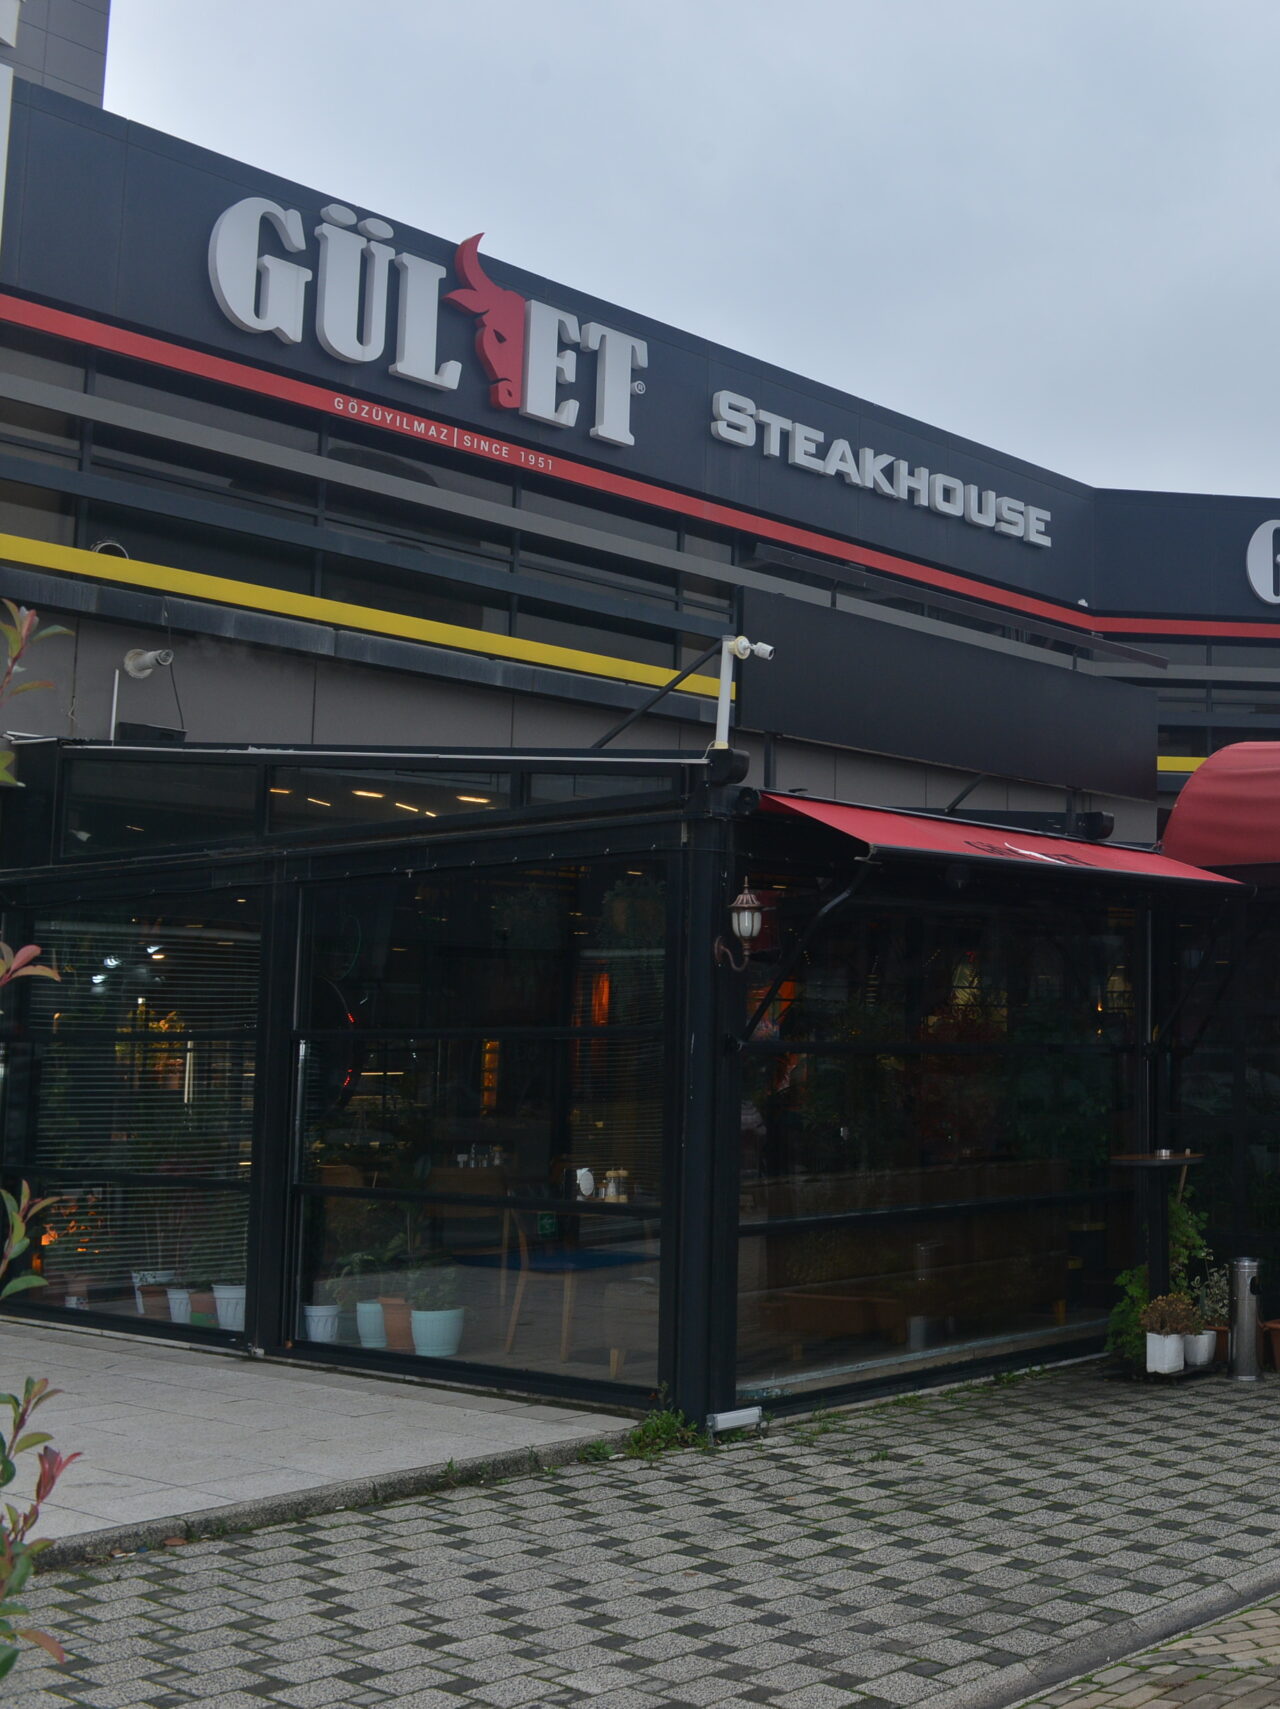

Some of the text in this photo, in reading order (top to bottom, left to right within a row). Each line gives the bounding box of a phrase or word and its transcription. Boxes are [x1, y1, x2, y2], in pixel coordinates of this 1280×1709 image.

[208, 196, 649, 447] GÜL ET
[334, 397, 554, 471] GÖZÜYILMAZ SINCE 1951
[711, 390, 1052, 548] STEAKHOUSE
